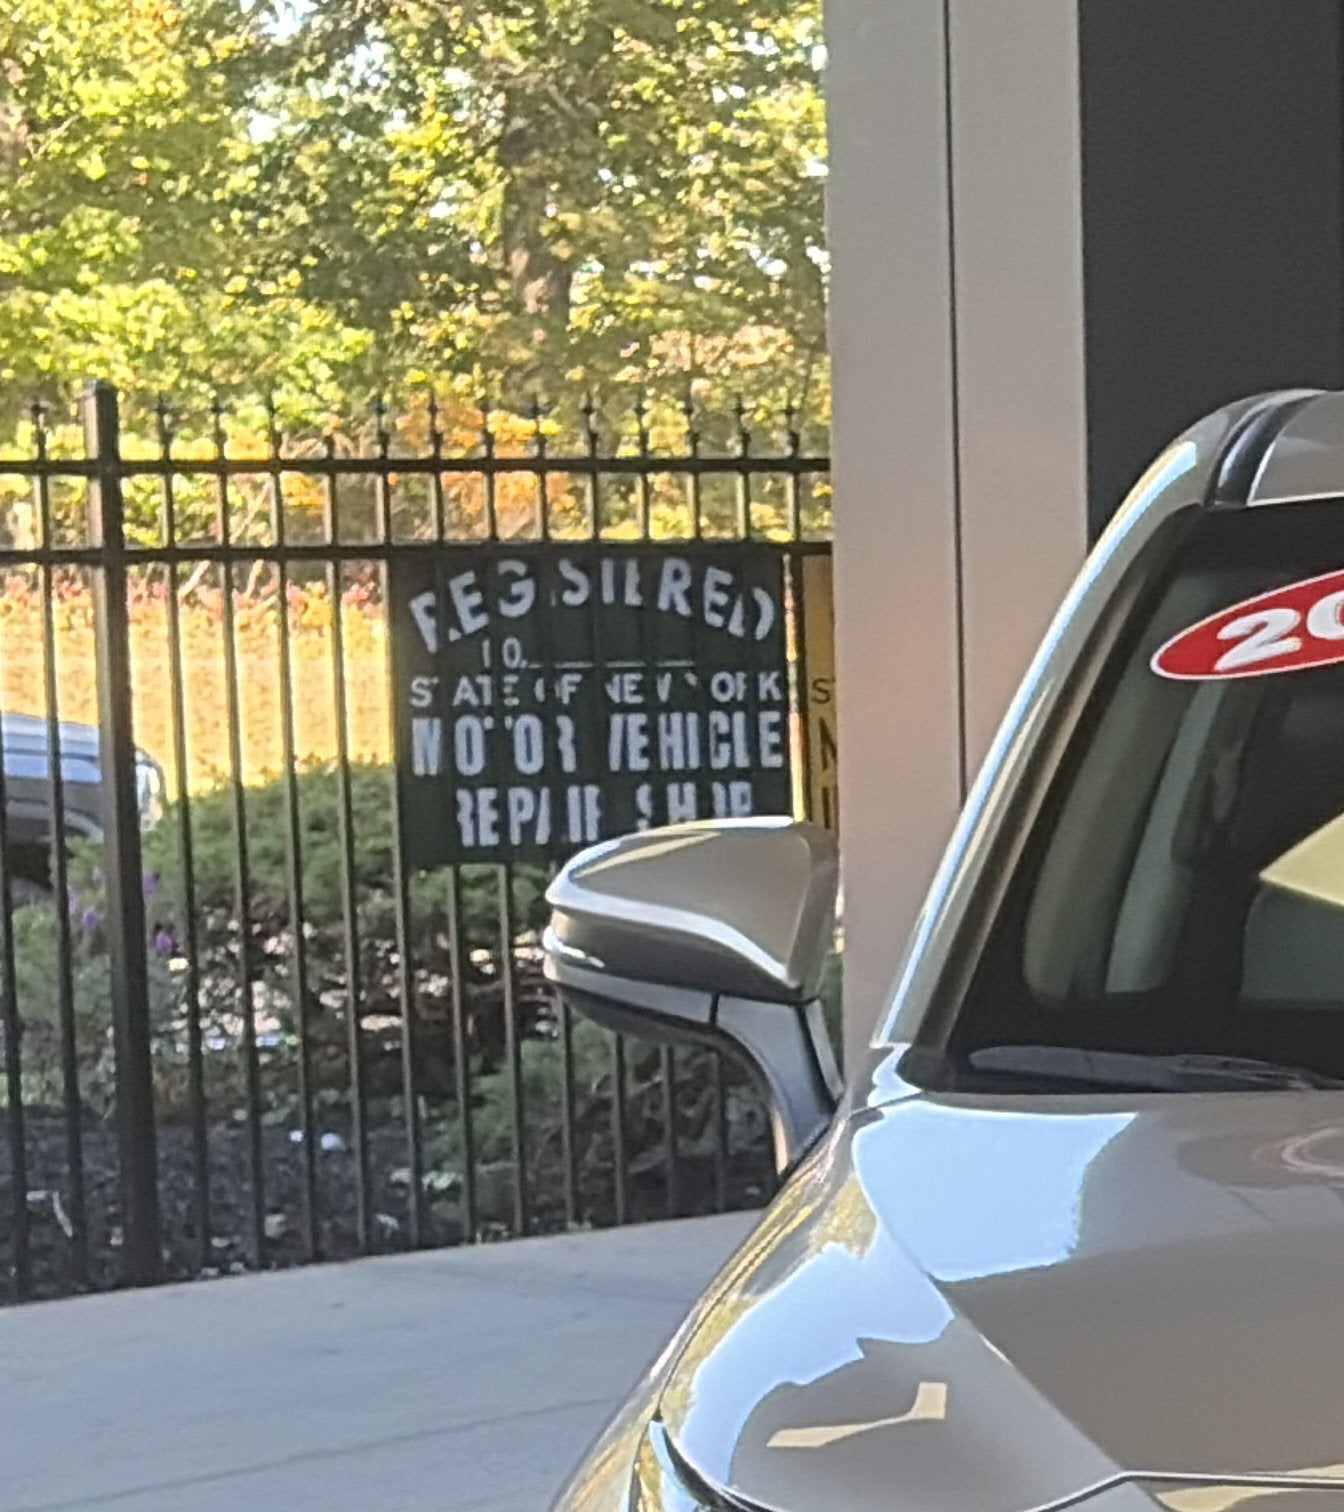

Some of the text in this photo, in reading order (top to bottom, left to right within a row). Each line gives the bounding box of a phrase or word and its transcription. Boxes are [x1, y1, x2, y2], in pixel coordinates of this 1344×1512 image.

[409, 557, 775, 653] REGSRED
[411, 674, 520, 708] SATE
[684, 670, 782, 702] ORK
[411, 714, 577, 776] MOOR
